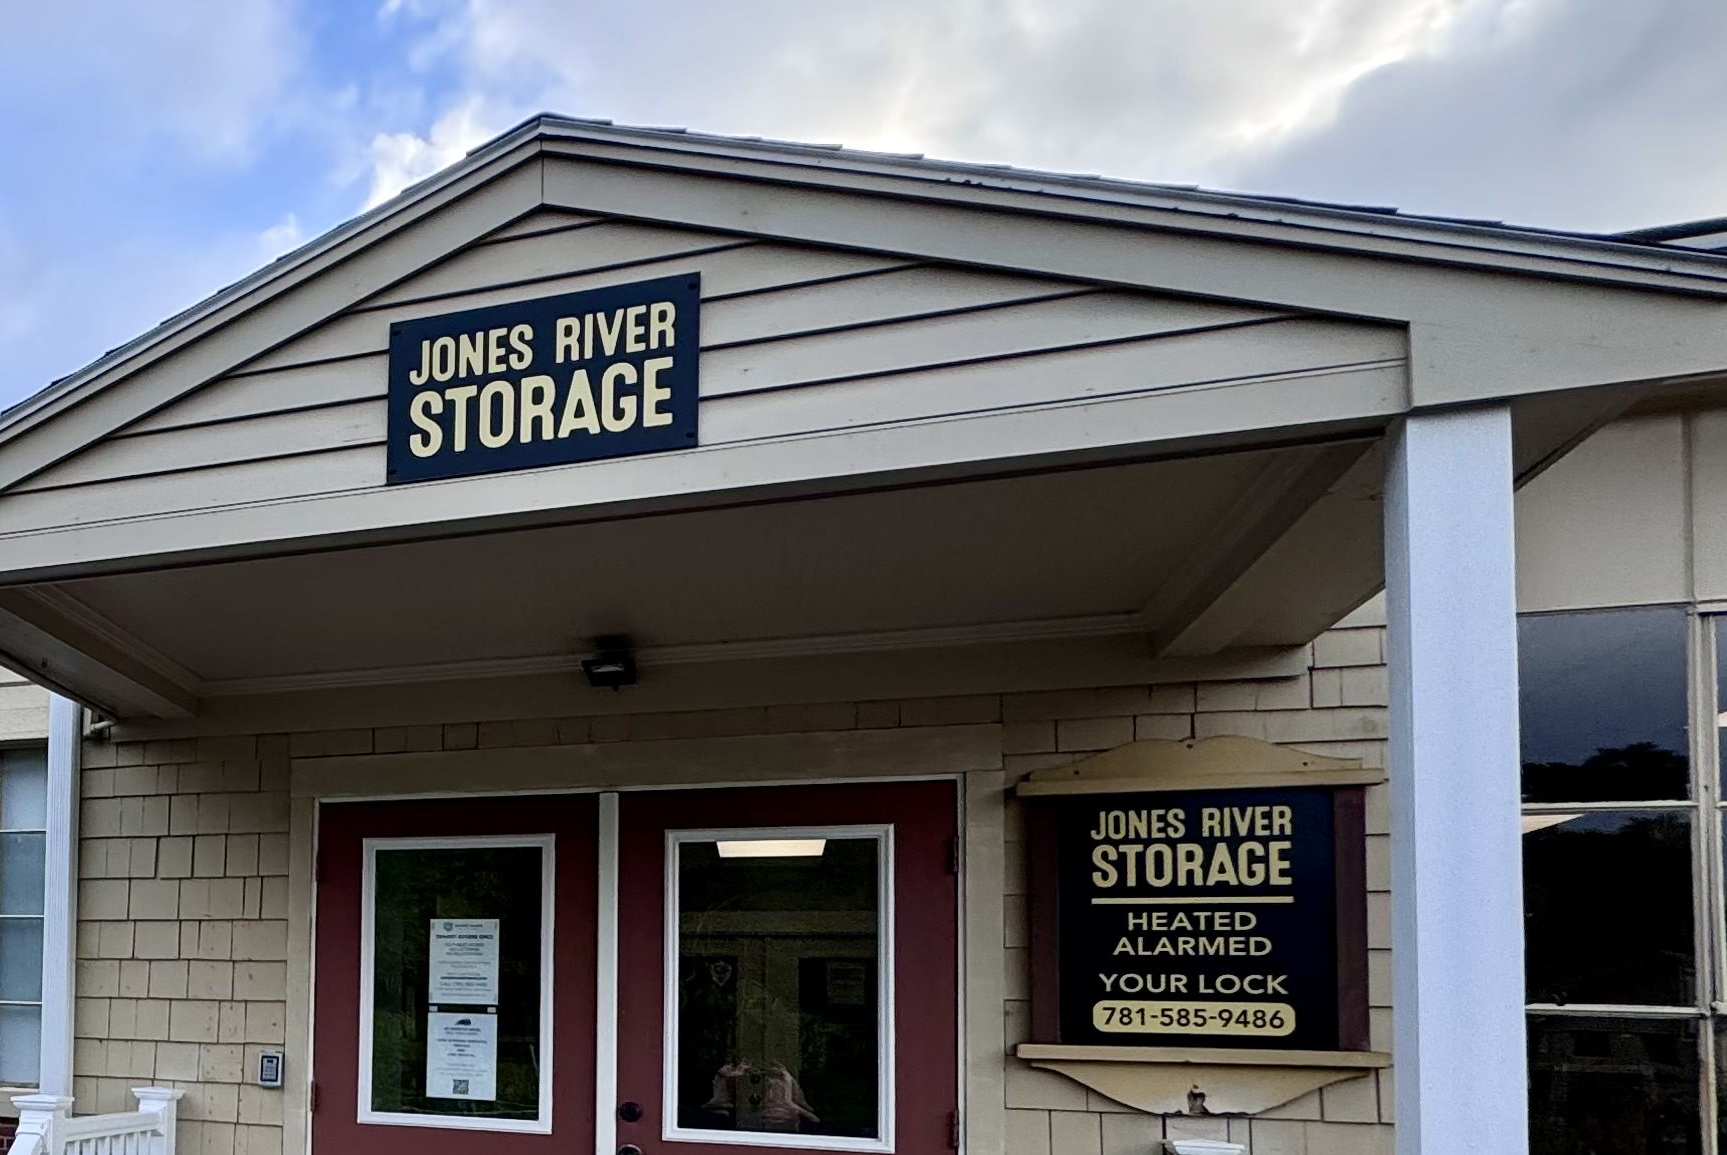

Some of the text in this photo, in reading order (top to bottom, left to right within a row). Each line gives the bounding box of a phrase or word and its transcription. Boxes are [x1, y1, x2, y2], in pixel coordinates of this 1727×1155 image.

[409, 301, 677, 386] JONES RIVER
[409, 356, 674, 458] STORAGE
[1090, 805, 1293, 840] JONES RIVER
[1091, 841, 1293, 888] STORAGE
[1127, 911, 1257, 931] HEATED
[1113, 937, 1273, 956] ALARMED
[1098, 973, 1289, 995] YOUR LOCK
[1102, 1007, 1285, 1029] 781-585-9486
